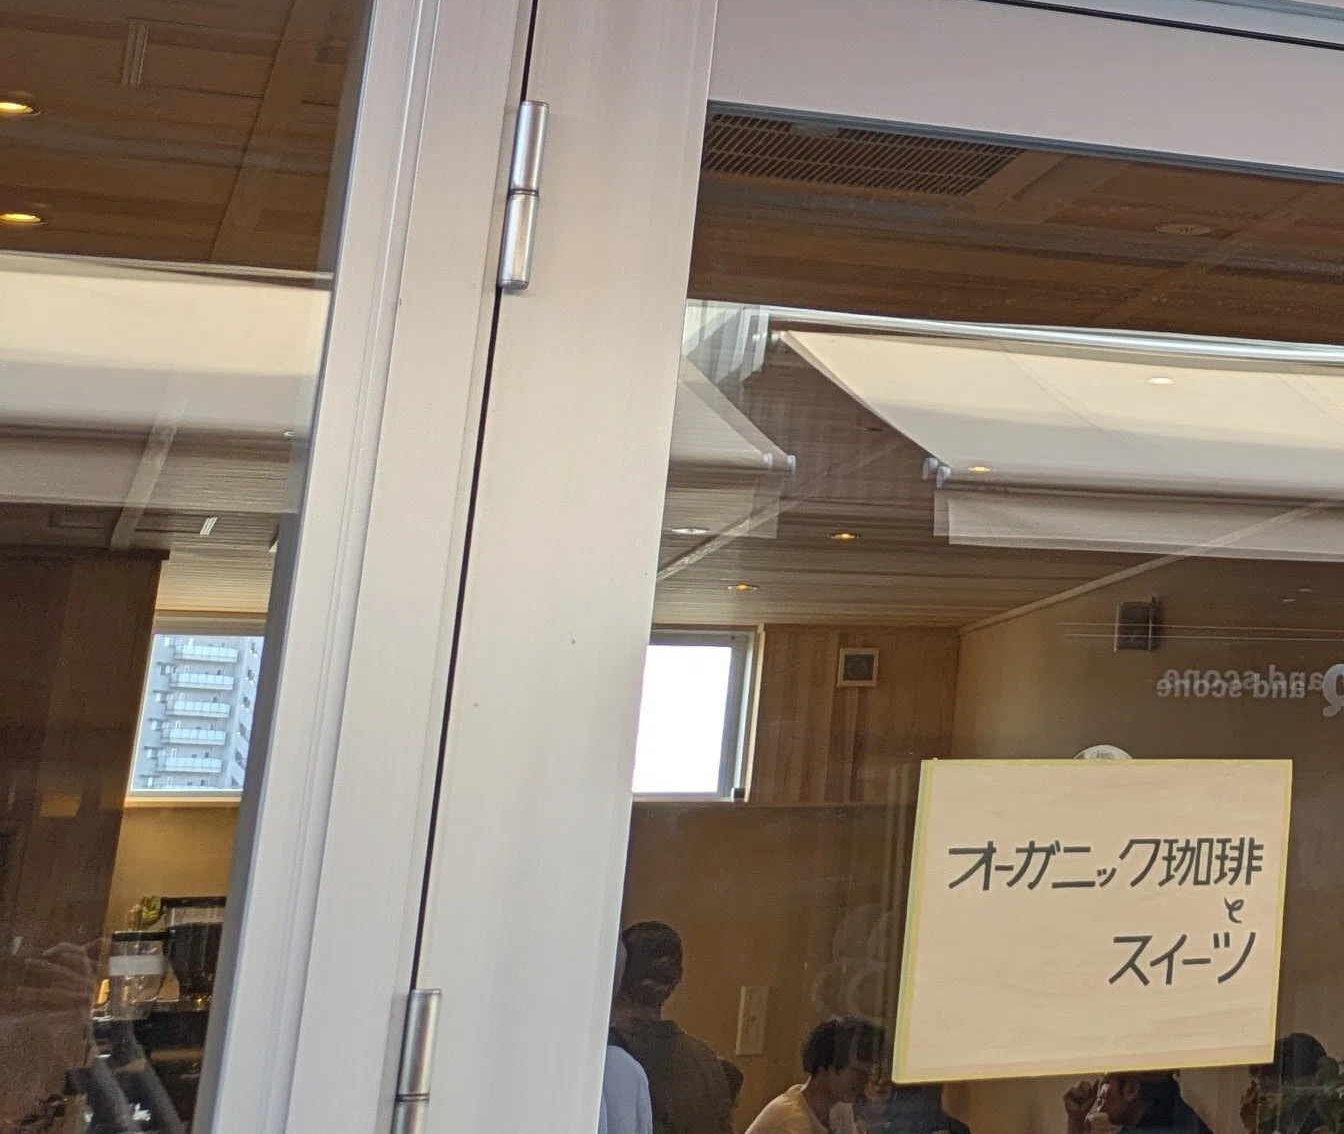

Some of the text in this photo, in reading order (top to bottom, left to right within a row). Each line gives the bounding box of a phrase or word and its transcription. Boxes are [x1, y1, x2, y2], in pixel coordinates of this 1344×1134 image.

[948, 837, 1264, 891] オーガニック珈琲
[1224, 897, 1245, 924] と
[1108, 931, 1256, 986] スイーツ
